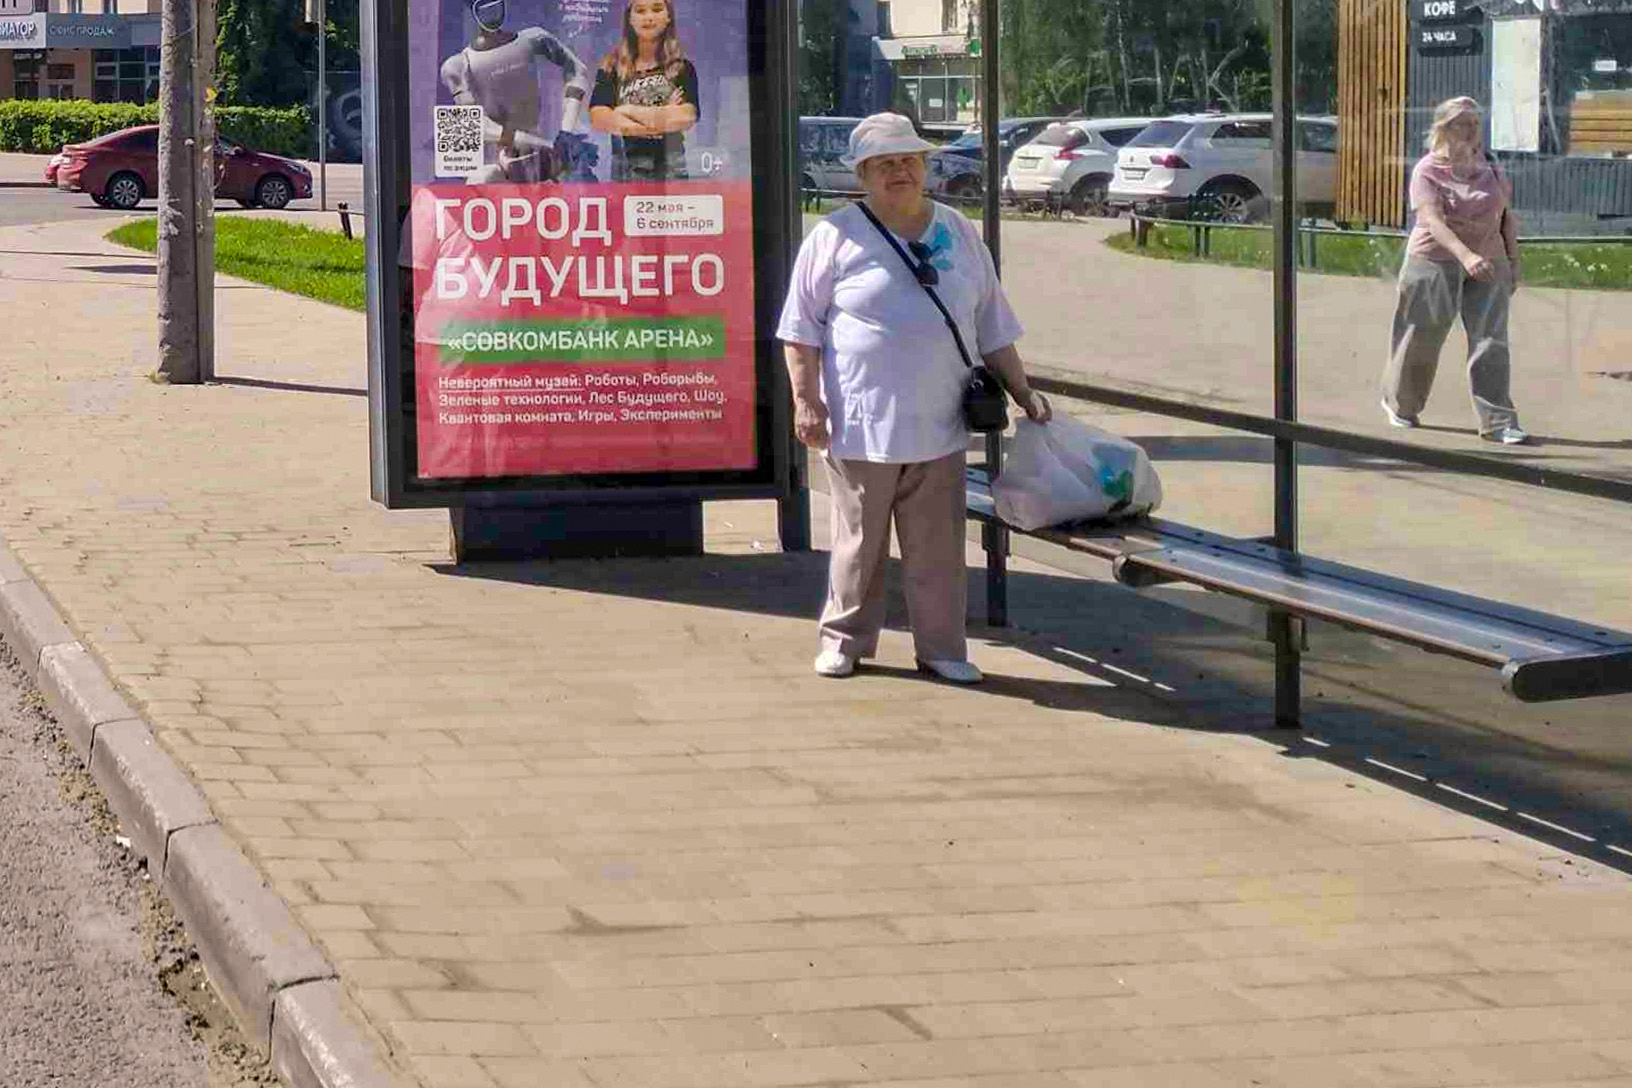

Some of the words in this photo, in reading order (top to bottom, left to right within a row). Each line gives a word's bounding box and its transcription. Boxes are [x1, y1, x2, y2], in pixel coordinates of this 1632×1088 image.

[1423, 0, 1456, 17] КОФЕ
[636, 201, 654, 213] 22
[657, 203, 685, 214] мая
[435, 196, 613, 248] ГОРОД
[636, 217, 646, 229] 6
[649, 215, 715, 231] сентября
[435, 253, 725, 306] БУДУЩЕГО
[448, 324, 620, 353] «СОВКОМБАНК
[624, 327, 714, 350] АРЕНА»
[438, 376, 532, 391] Невероятный
[535, 374, 582, 390] музей:
[584, 373, 639, 388] Роботы,
[505, 392, 587, 406] технологии,
[588, 391, 615, 403] Лес
[618, 390, 691, 406] Будущего,
[438, 411, 512, 425] Квантовая
[514, 411, 576, 424] комната,
[578, 409, 617, 424] Игры,
[620, 408, 723, 423] Эксперименты
